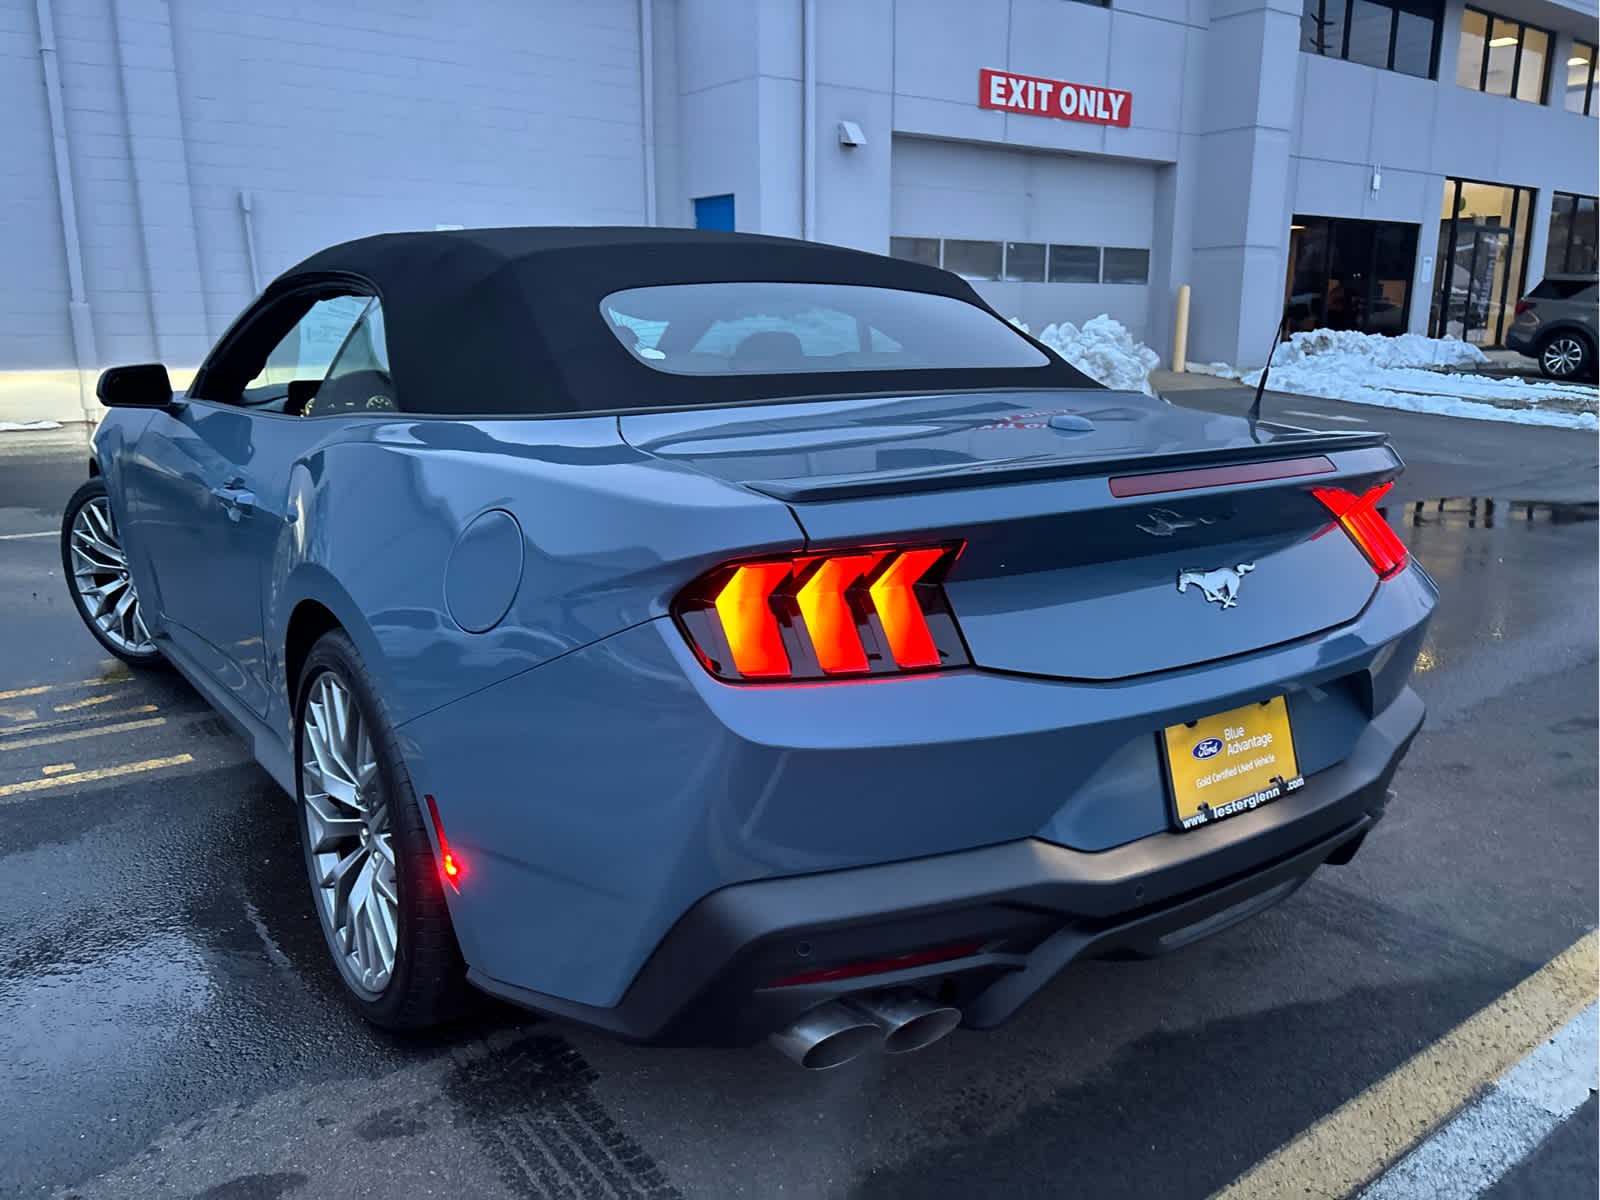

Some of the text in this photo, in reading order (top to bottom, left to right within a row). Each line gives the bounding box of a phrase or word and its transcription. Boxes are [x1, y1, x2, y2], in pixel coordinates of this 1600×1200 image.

[990, 75, 1125, 120] EXIT ONLY
[1224, 726, 1245, 741] Blue
[1227, 733, 1273, 756] Advantage
[1198, 741, 1218, 757] Ford
[1196, 754, 1275, 788] Gold Certified Used Vehicle
